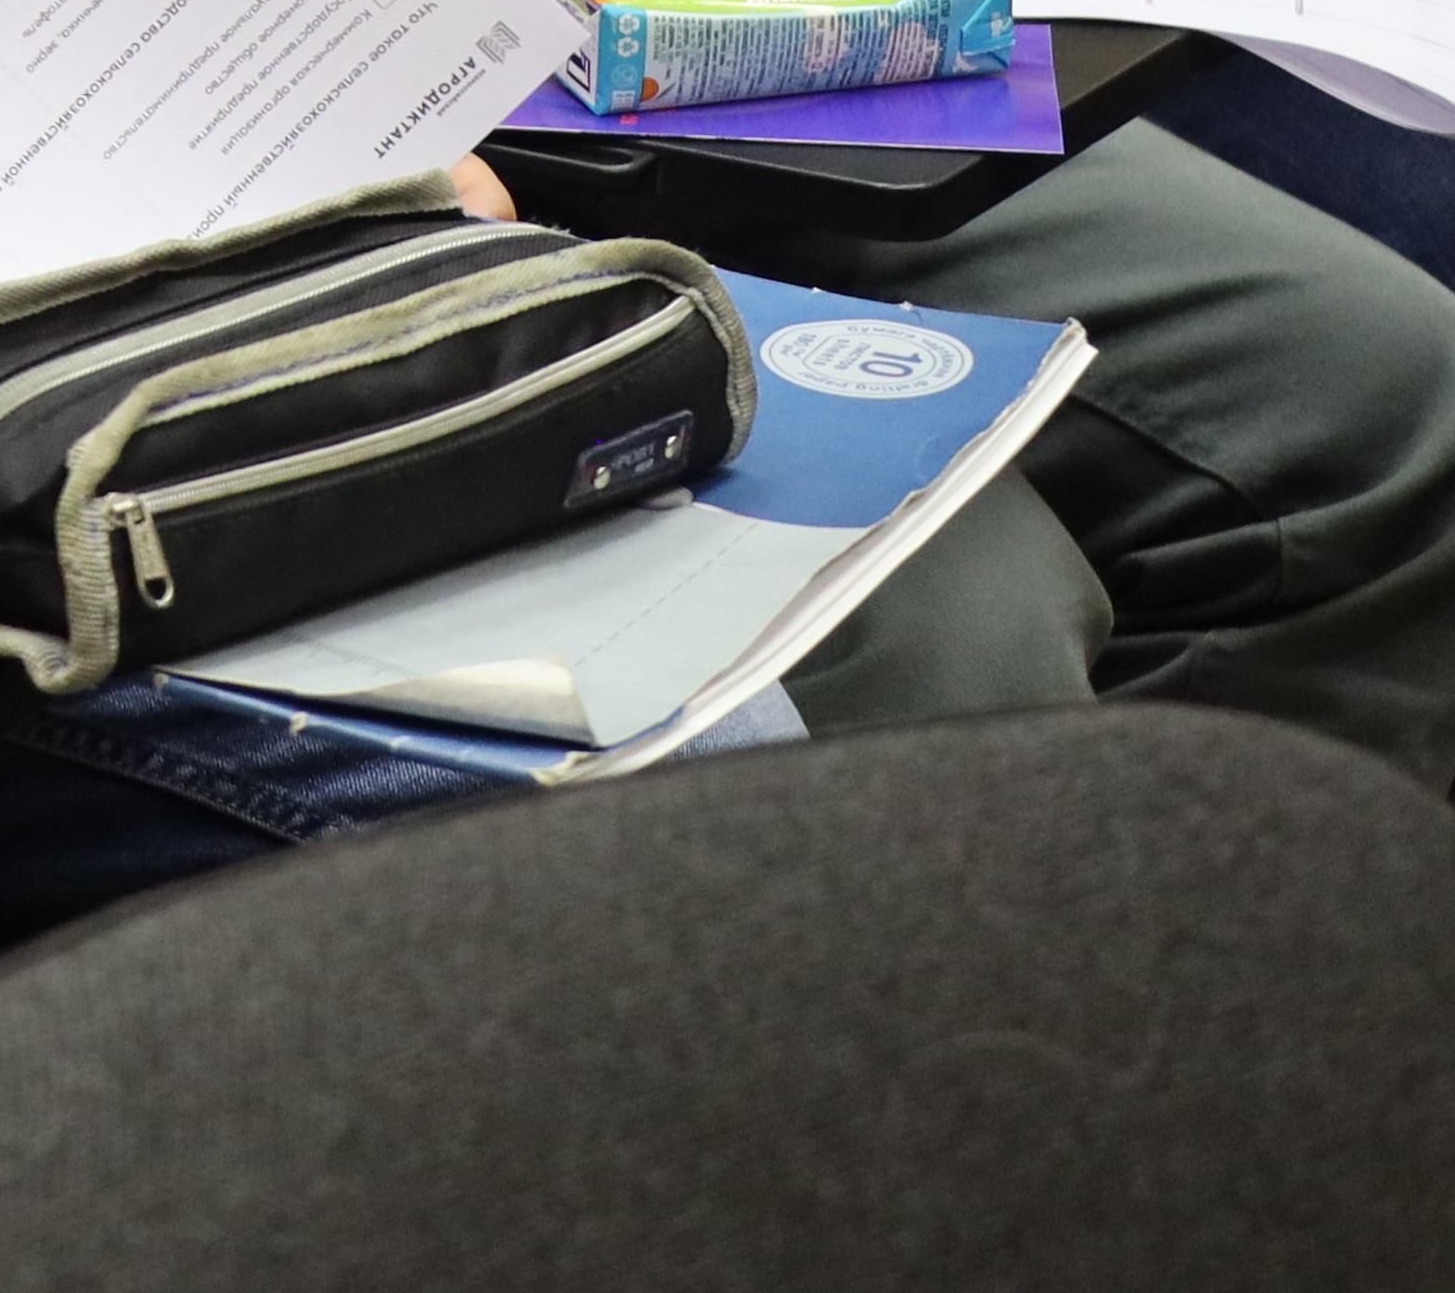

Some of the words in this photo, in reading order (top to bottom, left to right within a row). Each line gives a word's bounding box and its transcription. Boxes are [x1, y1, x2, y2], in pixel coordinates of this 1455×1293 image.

[21, 37, 59, 74] зерно
[201, 39, 261, 97] общество
[286, 6, 373, 89] Коммерческая
[365, 21, 411, 66] такое
[0, 40, 142, 184] сельскохозяйственной
[98, 39, 221, 160] предпринимательство
[182, 76, 261, 152] предприятие
[216, 82, 292, 155] организация
[219, 57, 373, 209] сельскохозяйственный
[369, 54, 478, 159] АГРОДИКТАНТ
[859, 351, 923, 378] 10
